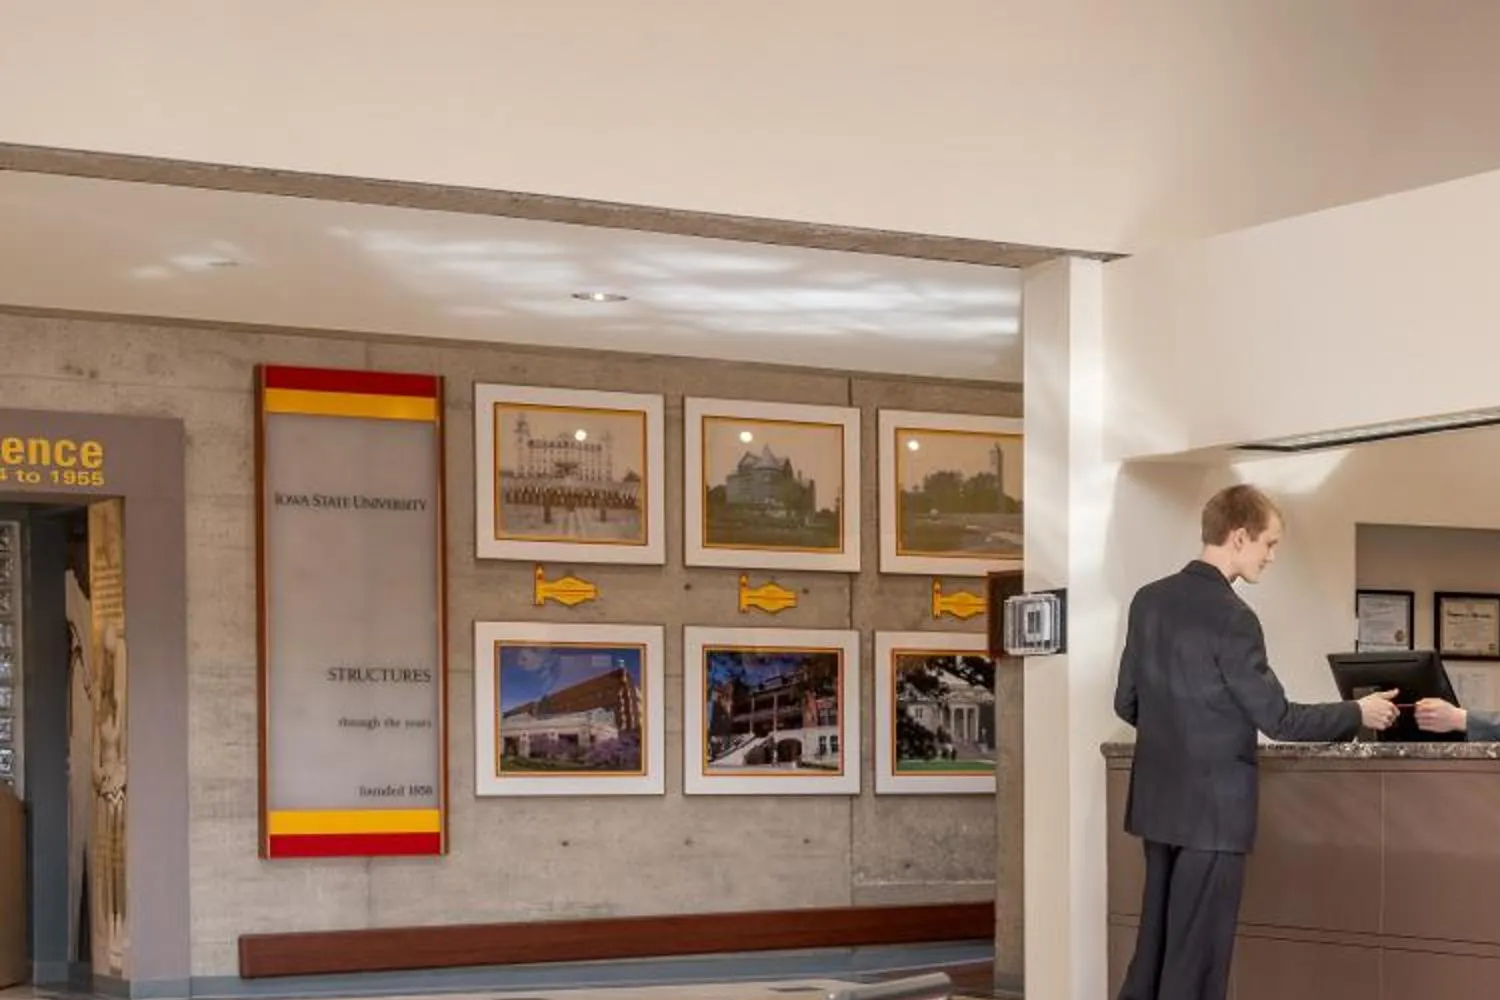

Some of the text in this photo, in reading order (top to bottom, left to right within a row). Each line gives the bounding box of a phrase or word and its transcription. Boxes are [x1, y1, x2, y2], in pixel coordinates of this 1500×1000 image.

[2, 437, 103, 468] ence
[16, 469, 41, 484] to
[50, 469, 105, 486] 1955
[352, 495, 427, 511] UNIVERSITY
[326, 666, 431, 683] STRUCTURES
[338, 716, 380, 731] through
[383, 717, 401, 728] the
